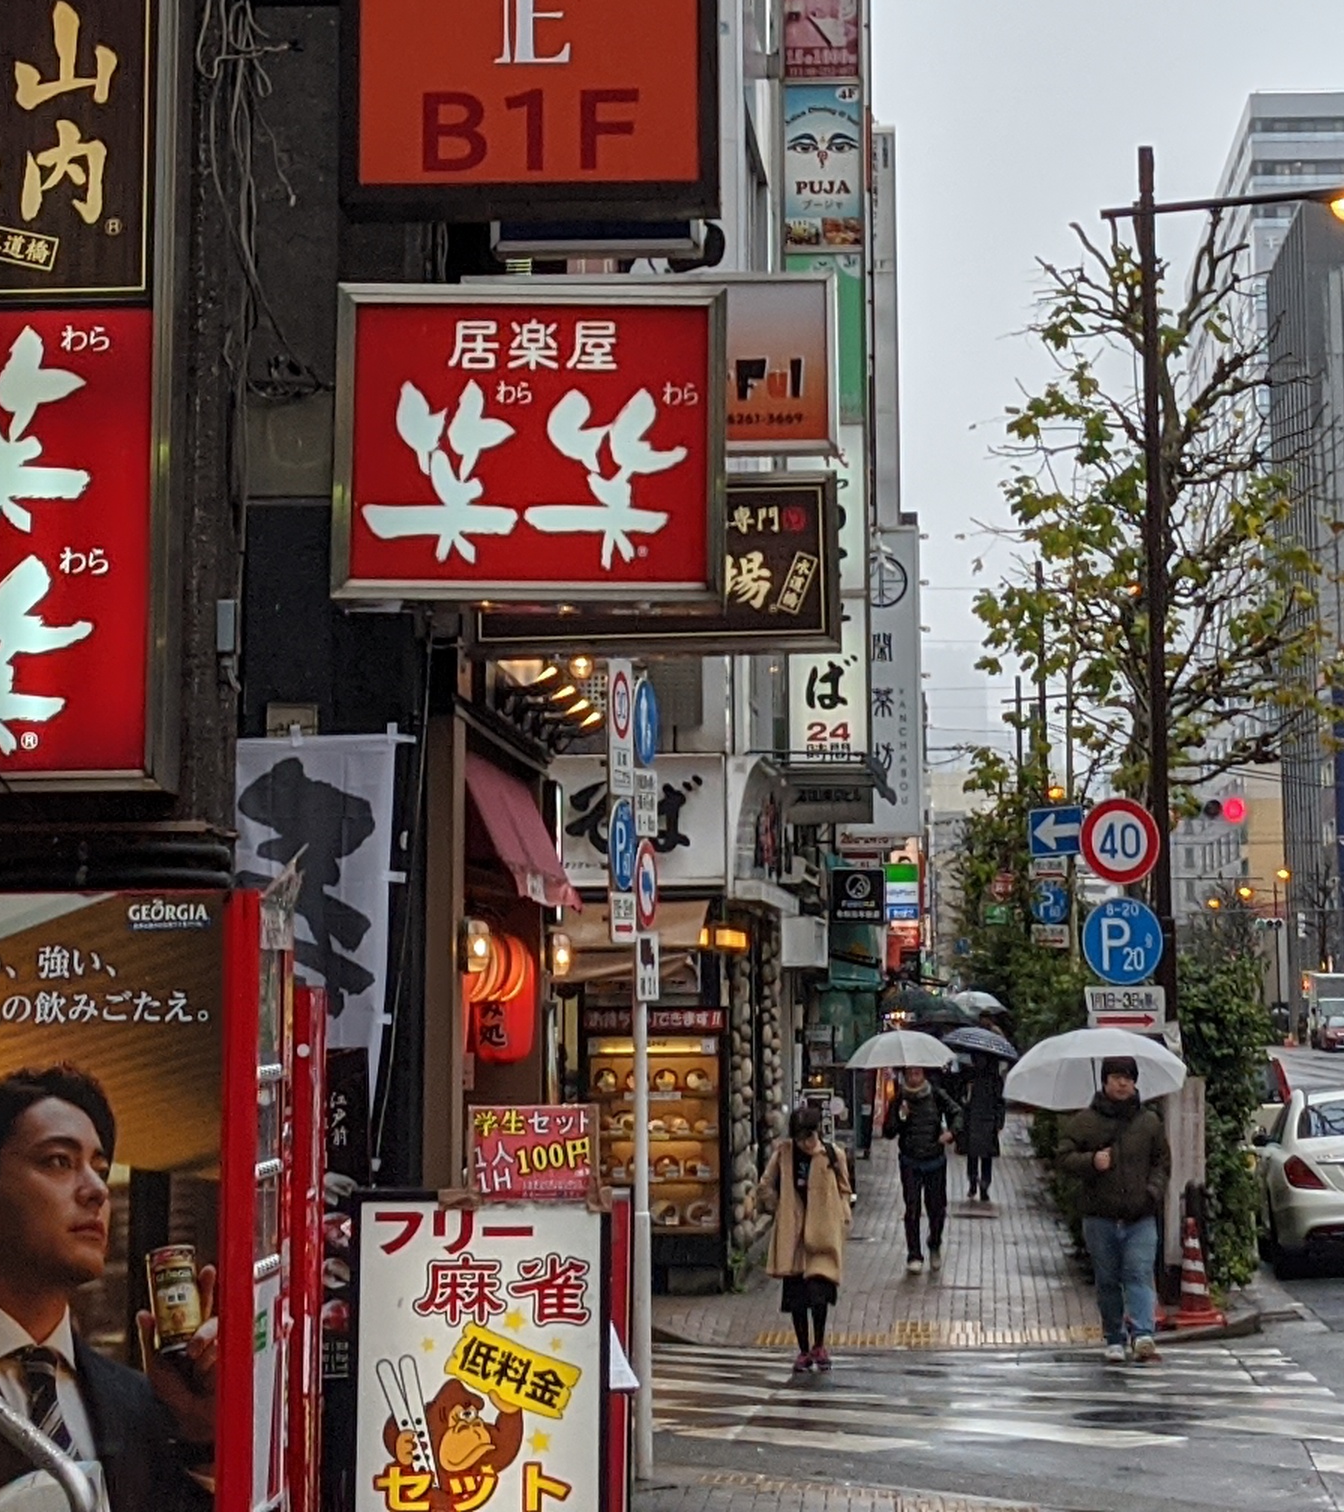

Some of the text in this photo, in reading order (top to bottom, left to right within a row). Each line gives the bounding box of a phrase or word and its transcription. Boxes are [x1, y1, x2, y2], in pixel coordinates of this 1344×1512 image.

[15, 0, 119, 225] 山内
[421, 88, 640, 174] B1F
[795, 180, 851, 196] PUJA
[61, 325, 110, 352] わら
[448, 320, 618, 370] 居楽屋
[495, 381, 532, 404] わら
[662, 382, 699, 405] わら
[60, 547, 109, 574] わら
[807, 722, 850, 742] 24
[1099, 822, 1142, 859] 40
[128, 898, 208, 921] GEORGIA
[1106, 904, 1139, 916] 8-20
[1100, 918, 1131, 971] P
[1122, 947, 1144, 971] 20
[474, 1108, 589, 1136] 学生セット
[516, 1137, 591, 1175] 100円
[374, 1210, 534, 1255] フリー
[415, 1253, 590, 1327] 麻雀
[459, 1334, 567, 1411] 低料金
[373, 1459, 573, 1512] セット
